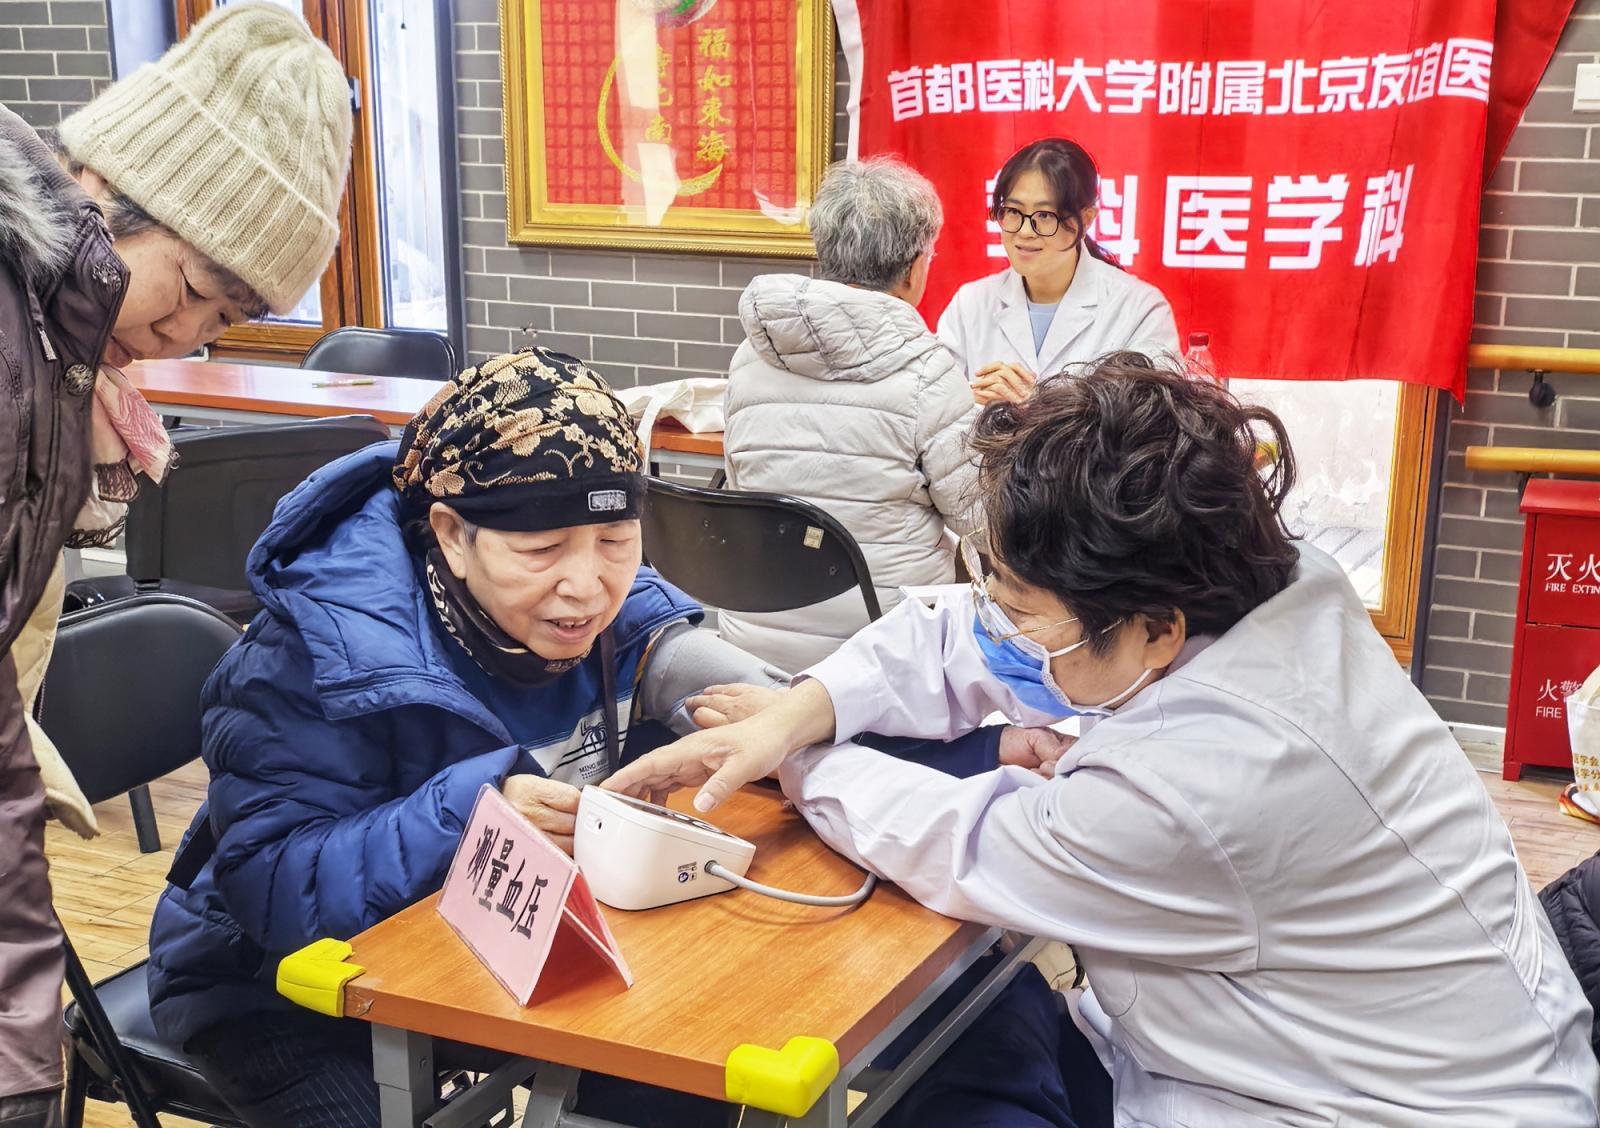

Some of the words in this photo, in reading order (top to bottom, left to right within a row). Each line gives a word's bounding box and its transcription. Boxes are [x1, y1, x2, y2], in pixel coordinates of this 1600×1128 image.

[696, 27, 734, 163] 福如東海
[887, 38, 1494, 122] 首都医科大学附属北京友谊医
[985, 163, 1414, 270] 科医学科
[1545, 553, 1600, 583] 灭火
[1545, 582, 1567, 593] FIRE
[1535, 706, 1563, 719] FIRE
[466, 824, 549, 940] 测量血压
